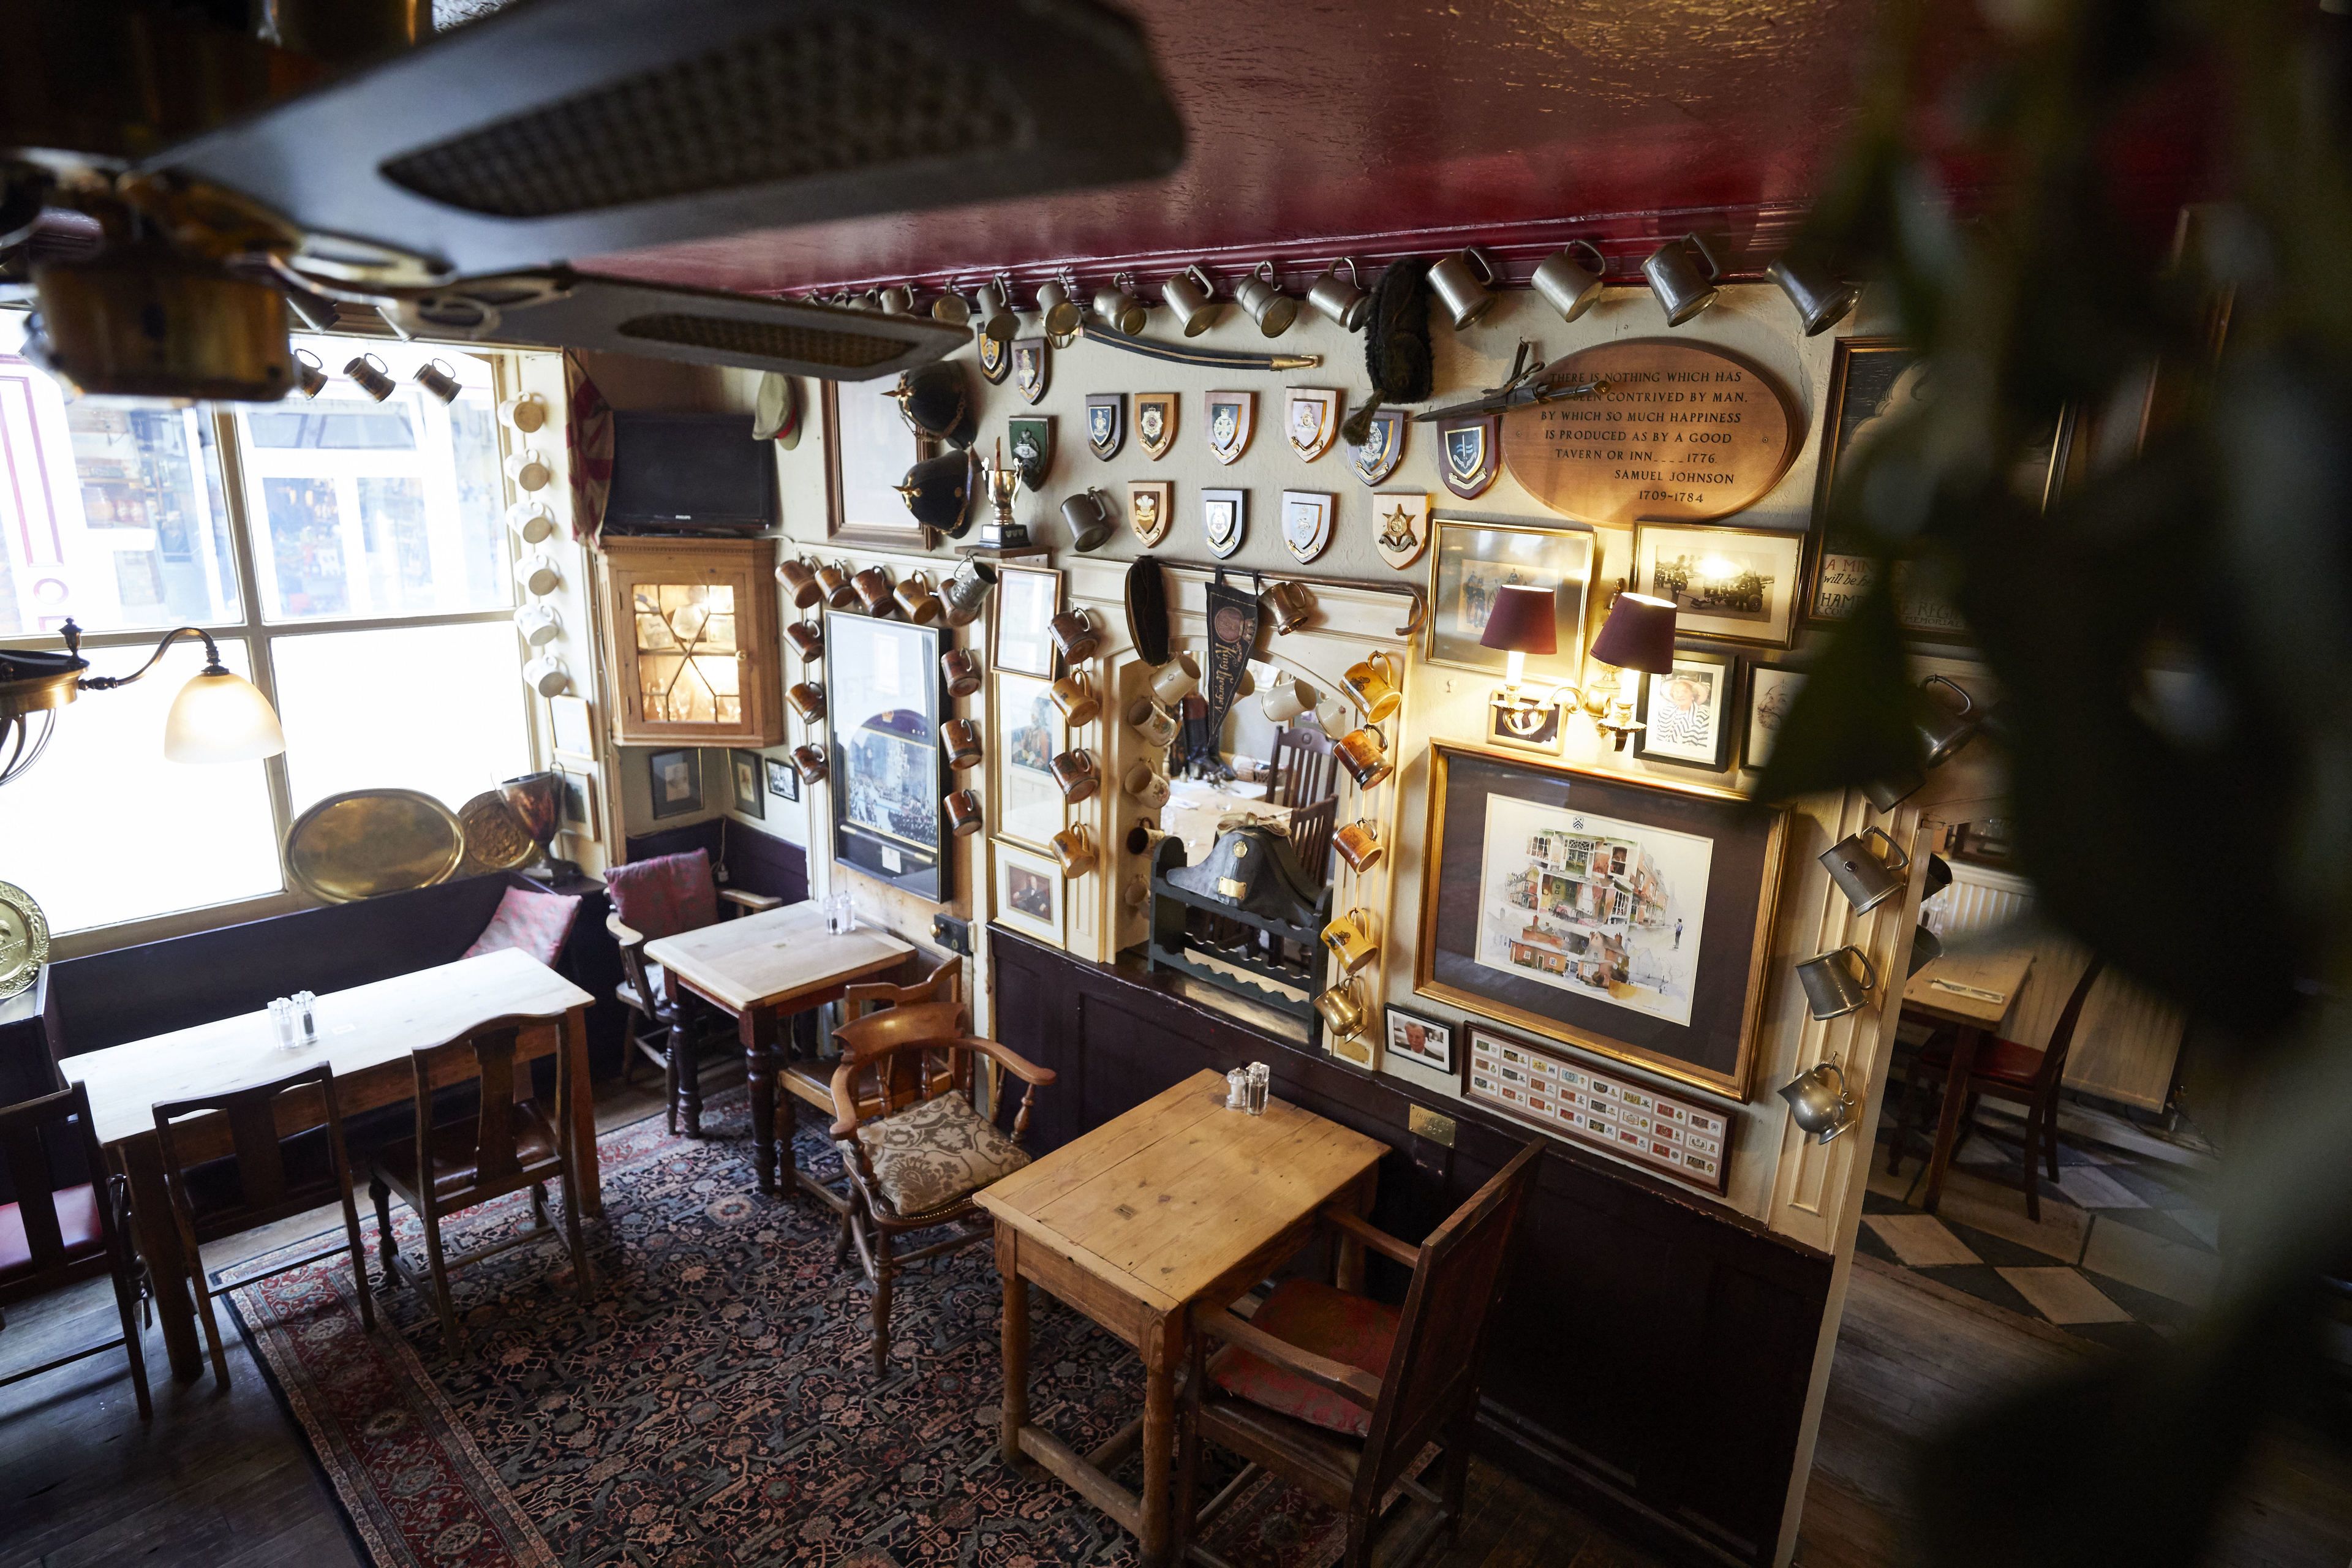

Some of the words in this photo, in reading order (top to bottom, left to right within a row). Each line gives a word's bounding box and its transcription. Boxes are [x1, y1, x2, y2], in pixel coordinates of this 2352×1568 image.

[1550, 372, 1585, 382] THERE
[1590, 372, 1599, 382] IS
[1604, 372, 1660, 382] NOTHING
[1667, 371, 1709, 382] WHICH
[1715, 371, 1742, 382] HAS
[1607, 392, 1684, 402] CONTRIVED
[1689, 392, 1707, 402] BY
[1713, 392, 1748, 402] MAN.
[1541, 411, 1556, 421] BY
[1561, 411, 1601, 421] WHICH
[1605, 411, 1623, 421] SO
[1627, 412, 1664, 422] MUCH
[1670, 412, 1741, 423] HAPPINESS
[1545, 429, 1555, 440] IS
[1559, 430, 1627, 441] PRODUCED
[1631, 431, 1648, 442] AS
[1653, 432, 1669, 442] BY
[1674, 432, 1683, 442] A
[1689, 432, 1732, 443] GOOD
[1555, 448, 1602, 459] TAVERN
[1607, 450, 1624, 460] OR
[1614, 469, 1664, 481] SAMUEL
[1668, 472, 1735, 484] JOHNSON
[1638, 490, 1704, 503] 1709-1784
[1823, 558, 1836, 571] A
[1823, 573, 1844, 584] will
[1843, 575, 1857, 586] be
